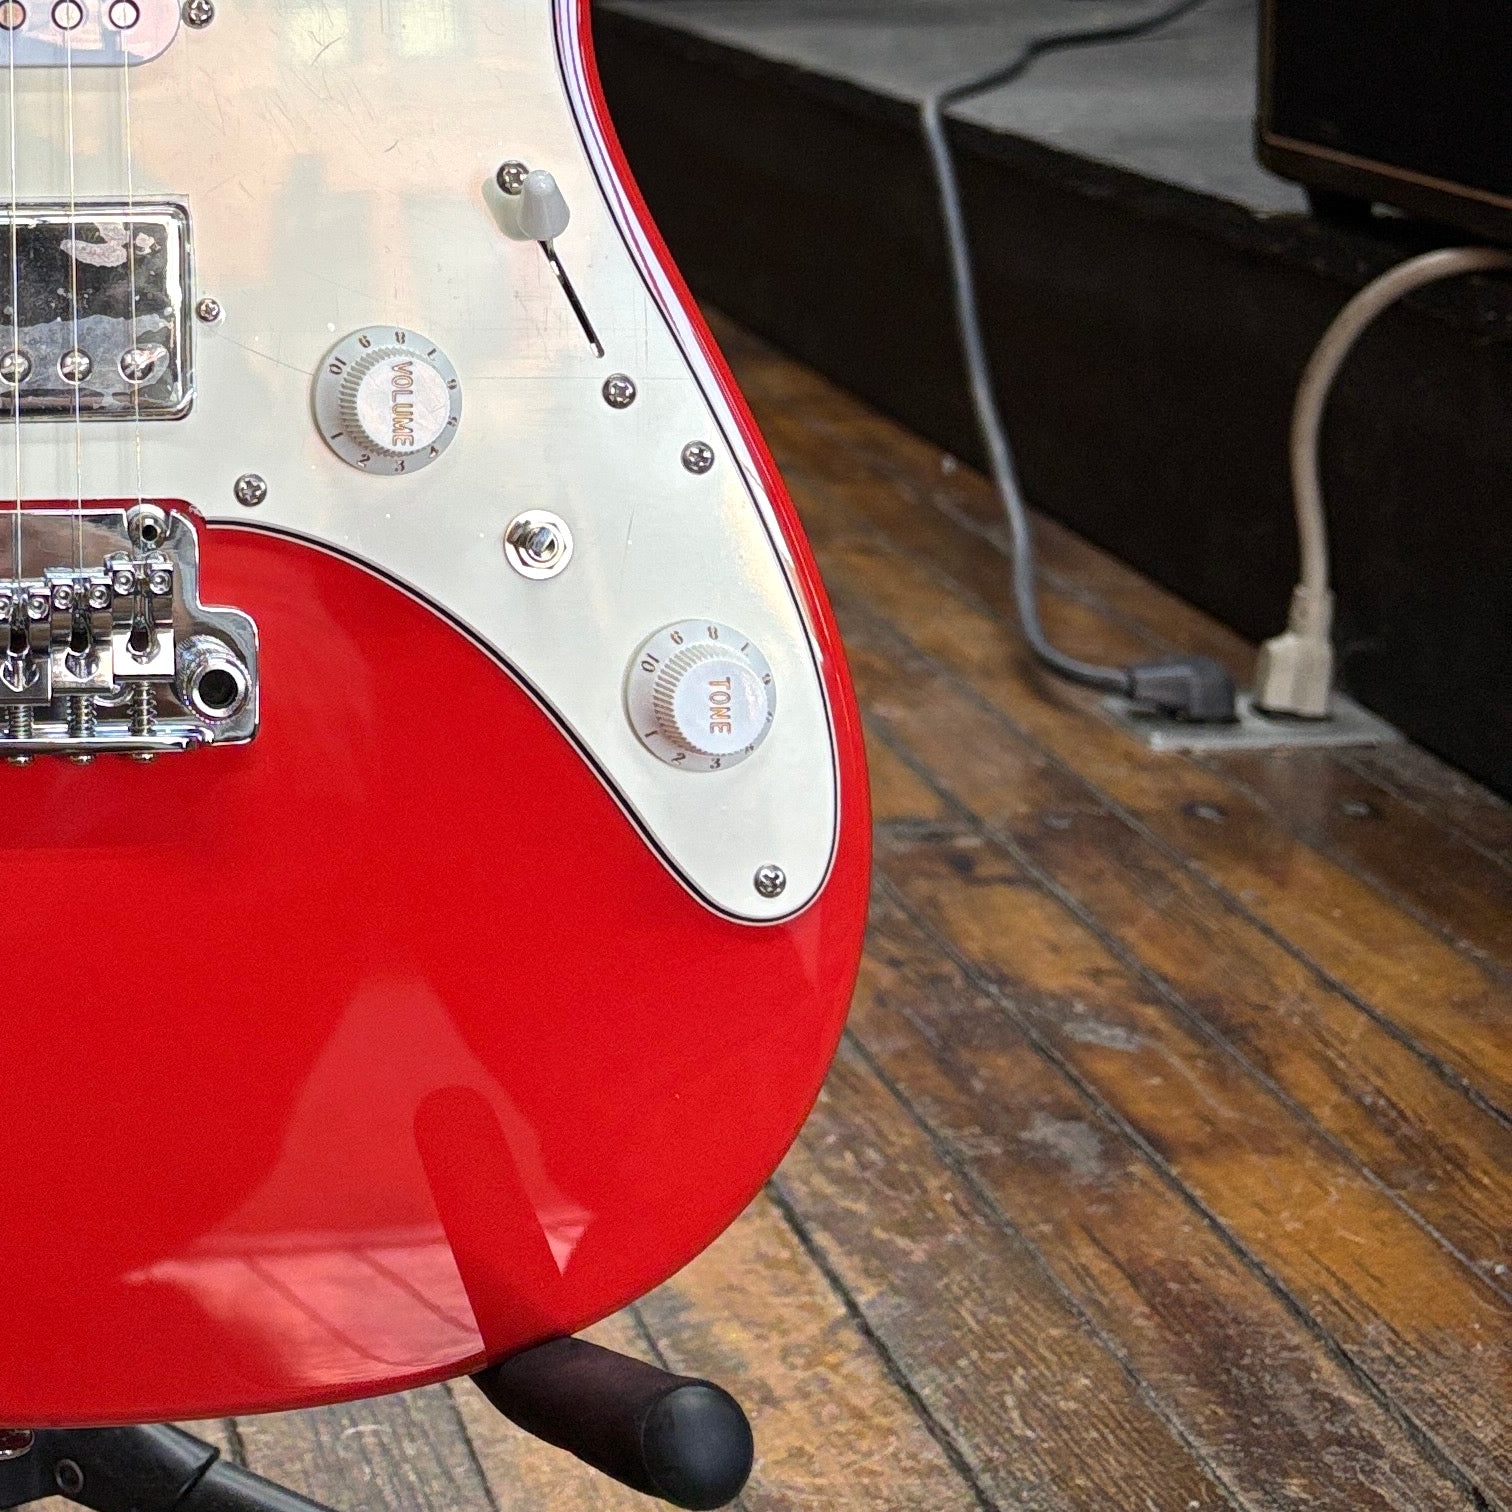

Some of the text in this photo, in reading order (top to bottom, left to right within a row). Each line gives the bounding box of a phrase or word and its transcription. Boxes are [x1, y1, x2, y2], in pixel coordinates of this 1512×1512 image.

[328, 355, 347, 376] 10
[391, 360, 415, 448] VOLUME
[640, 652, 661, 674] 10
[708, 675, 733, 736] TONE
